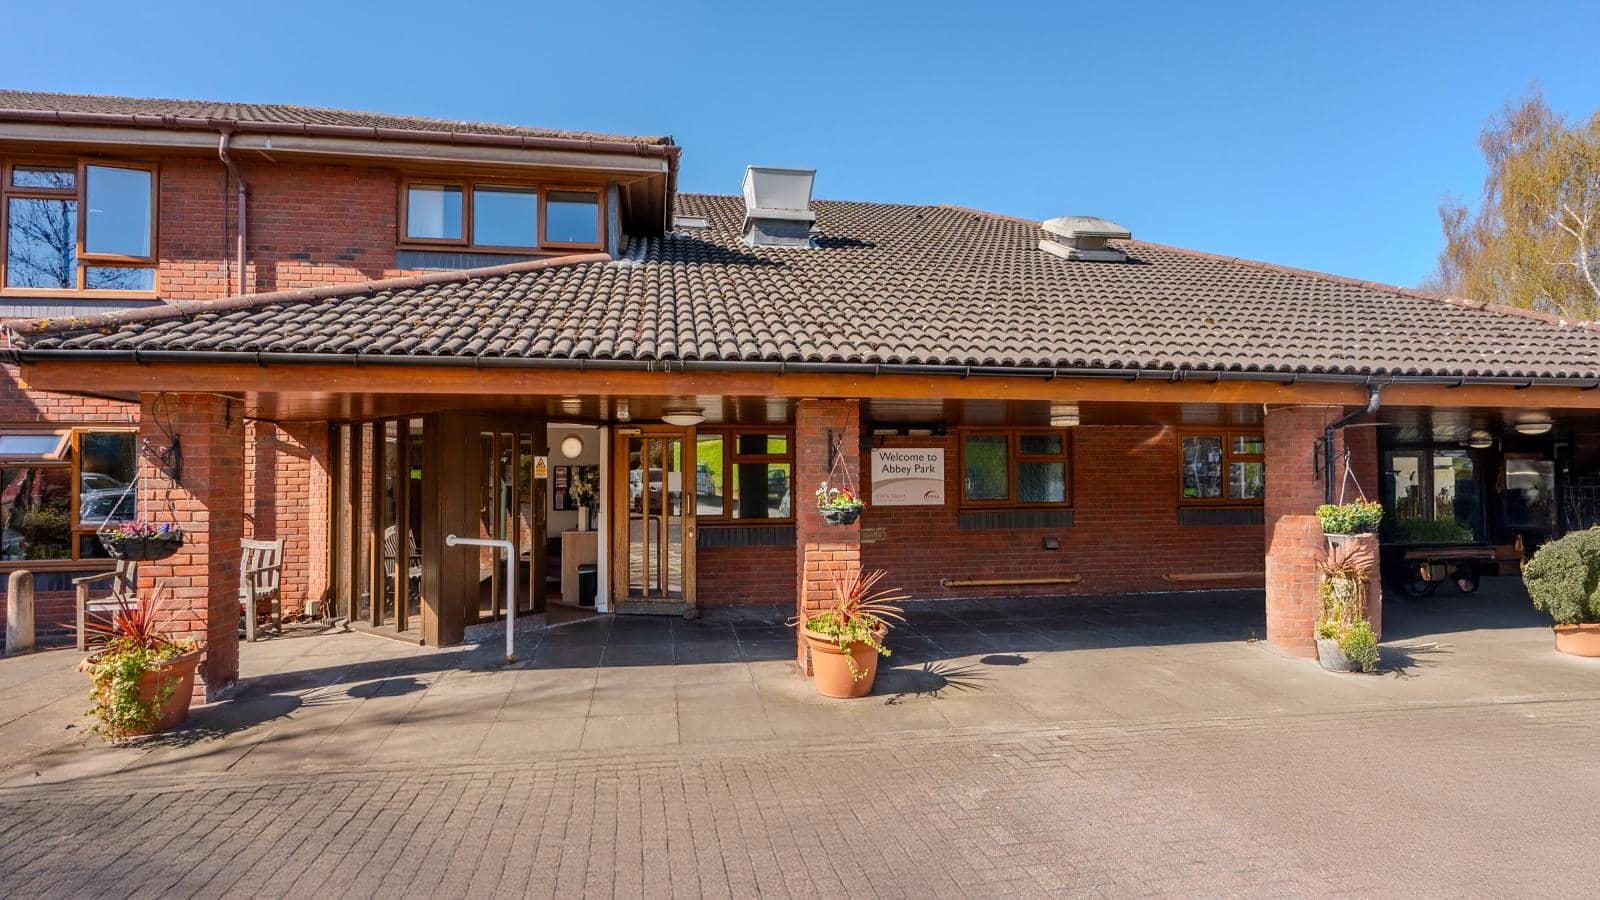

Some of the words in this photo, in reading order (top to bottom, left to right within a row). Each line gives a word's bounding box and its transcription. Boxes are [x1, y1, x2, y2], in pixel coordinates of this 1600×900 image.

[879, 452, 924, 461] Welcome
[881, 464, 911, 475] Abbey
[914, 464, 936, 473] Park
